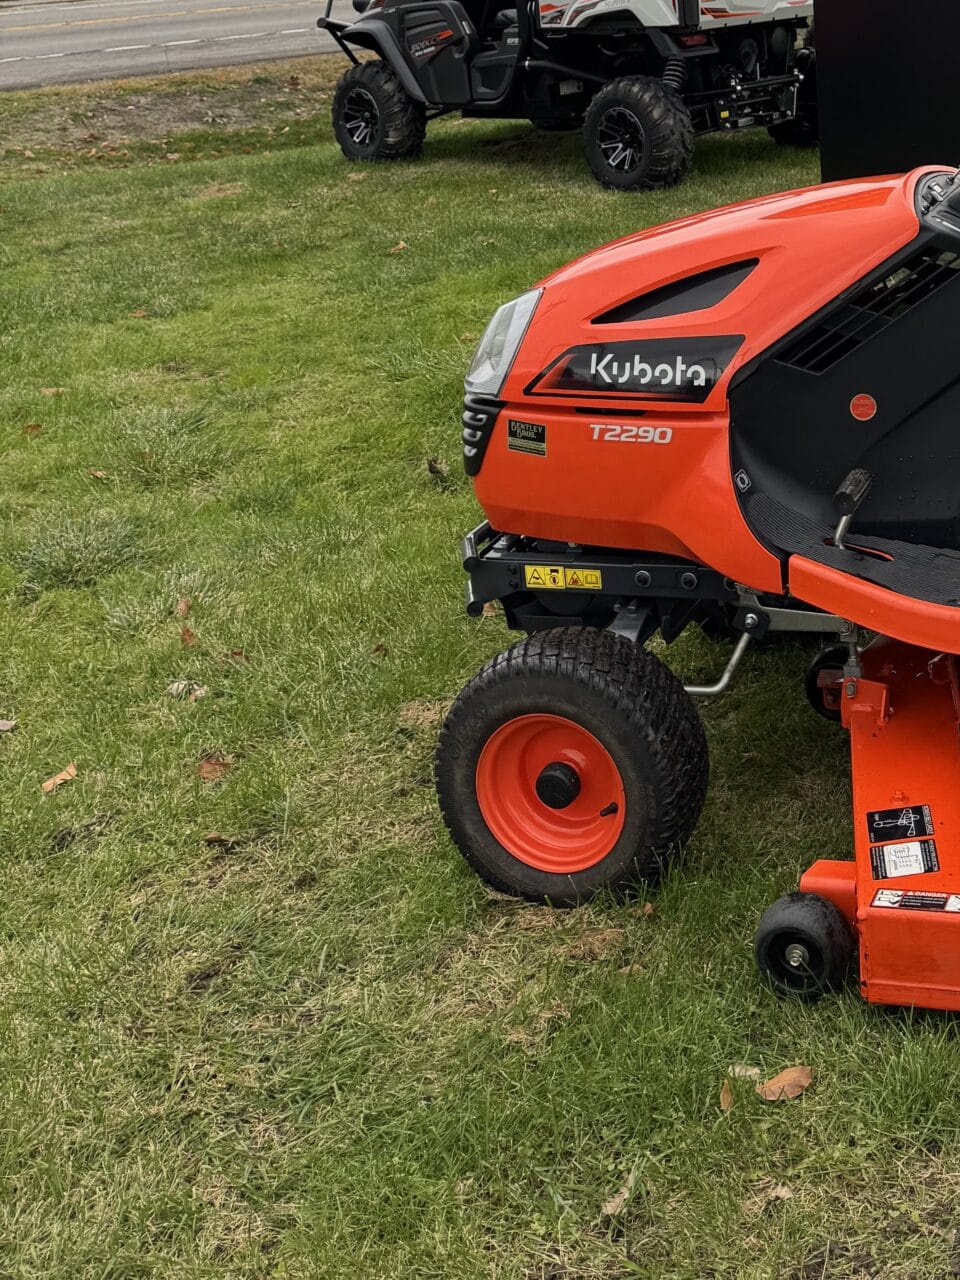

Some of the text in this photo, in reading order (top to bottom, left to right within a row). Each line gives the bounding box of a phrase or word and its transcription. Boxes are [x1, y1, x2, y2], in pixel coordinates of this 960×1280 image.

[589, 352, 707, 387] Kubota
[589, 423, 673, 444] T2290
[914, 891, 947, 899] DANGER
